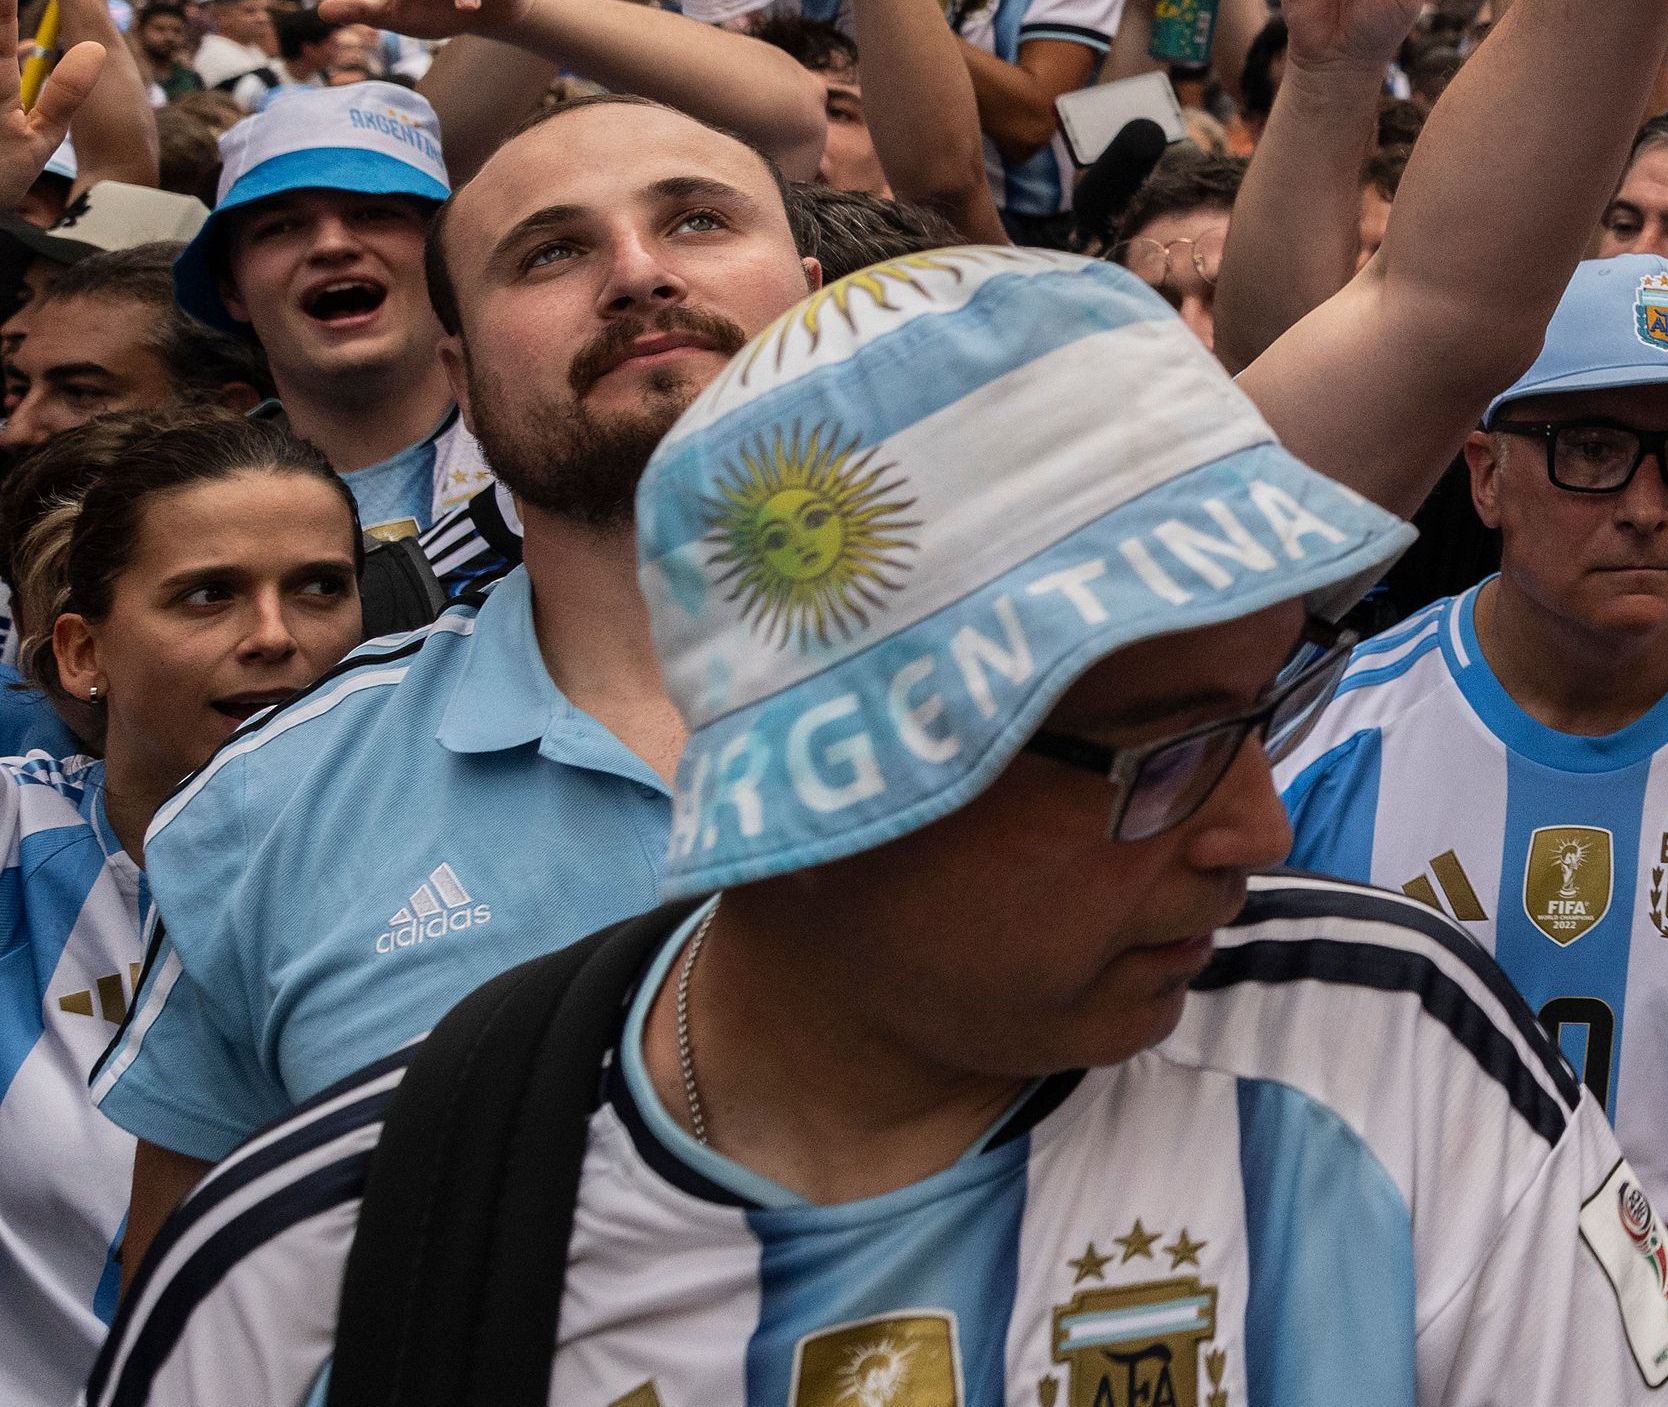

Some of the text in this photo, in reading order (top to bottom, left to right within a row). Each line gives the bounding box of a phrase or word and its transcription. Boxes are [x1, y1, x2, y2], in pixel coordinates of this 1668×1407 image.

[1548, 901, 1587, 915] FIFA
[376, 903, 493, 953] adidas
[1552, 921, 1577, 929] 2022
